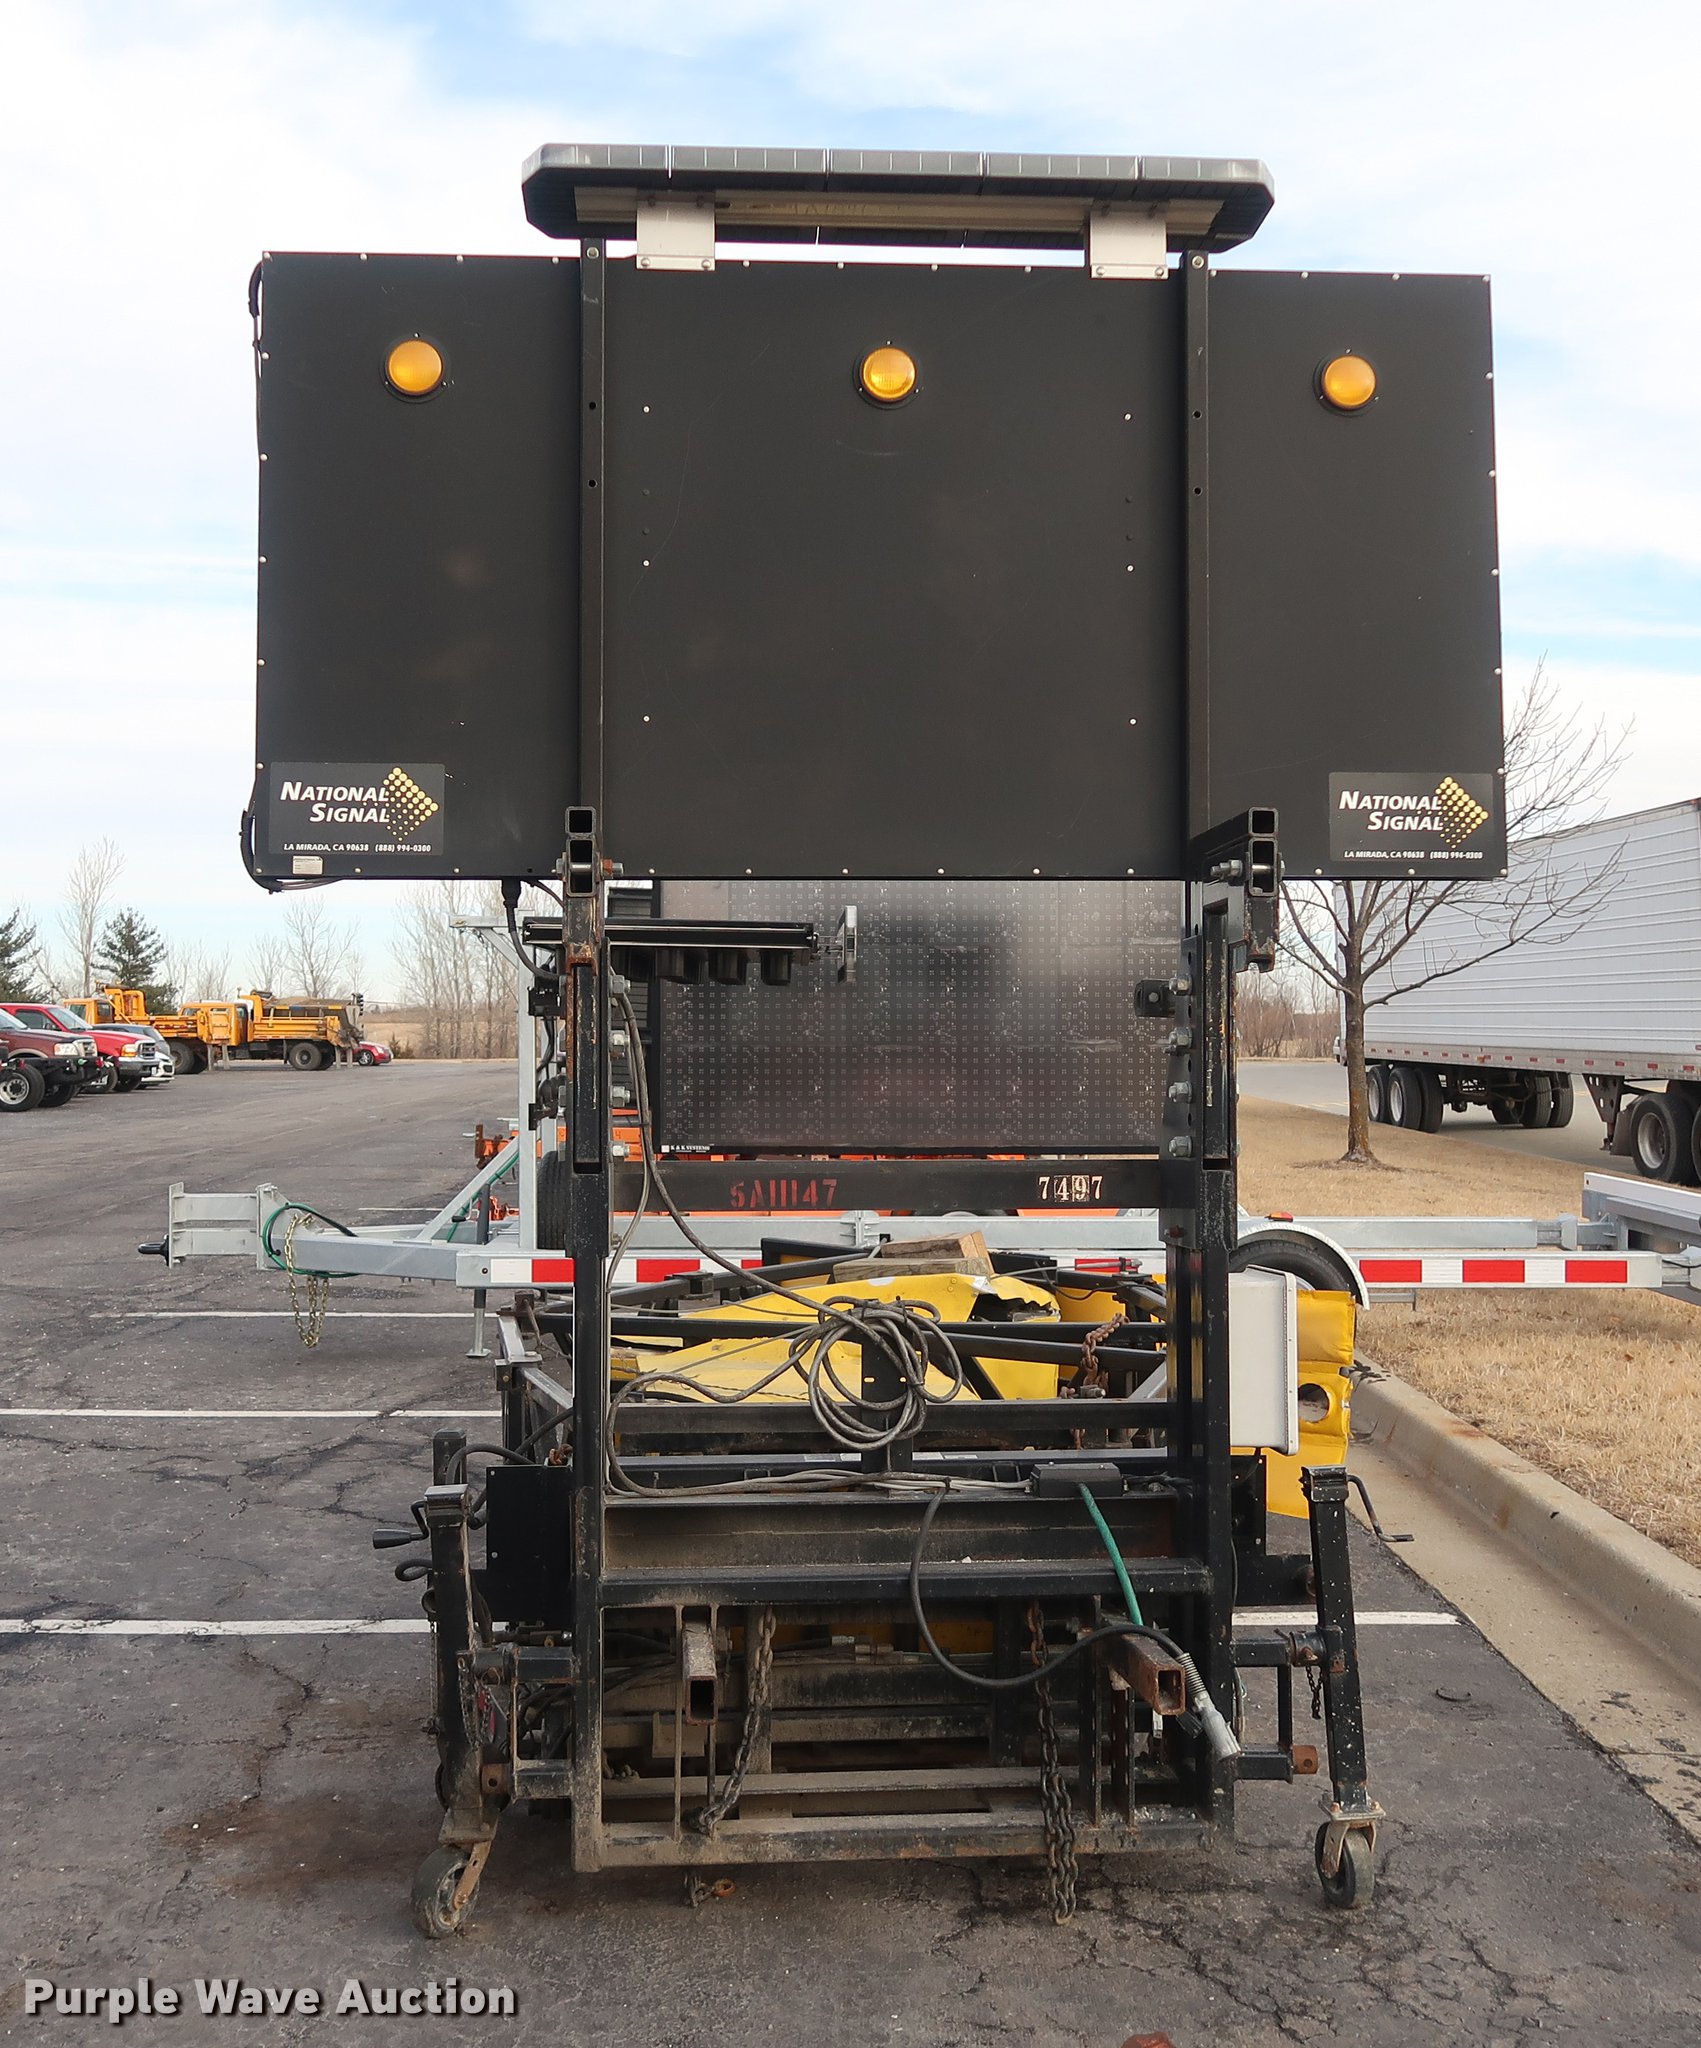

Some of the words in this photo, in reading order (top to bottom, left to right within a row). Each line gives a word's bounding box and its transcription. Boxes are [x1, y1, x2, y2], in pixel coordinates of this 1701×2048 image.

[280, 781, 389, 801] NATIONAL
[1339, 791, 1442, 810] NATIONAL
[309, 802, 390, 822] SIGNAL
[1367, 811, 1443, 831] SIGNAL
[283, 843, 294, 851] LA
[295, 843, 331, 852] MIRADA,
[332, 843, 344, 851] CA
[346, 844, 369, 852] 90638
[375, 843, 395, 853] (888)
[396, 844, 431, 853] 994-0300
[1355, 851, 1389, 859] MIRADA,
[1038, 1175, 1103, 1201] 7497
